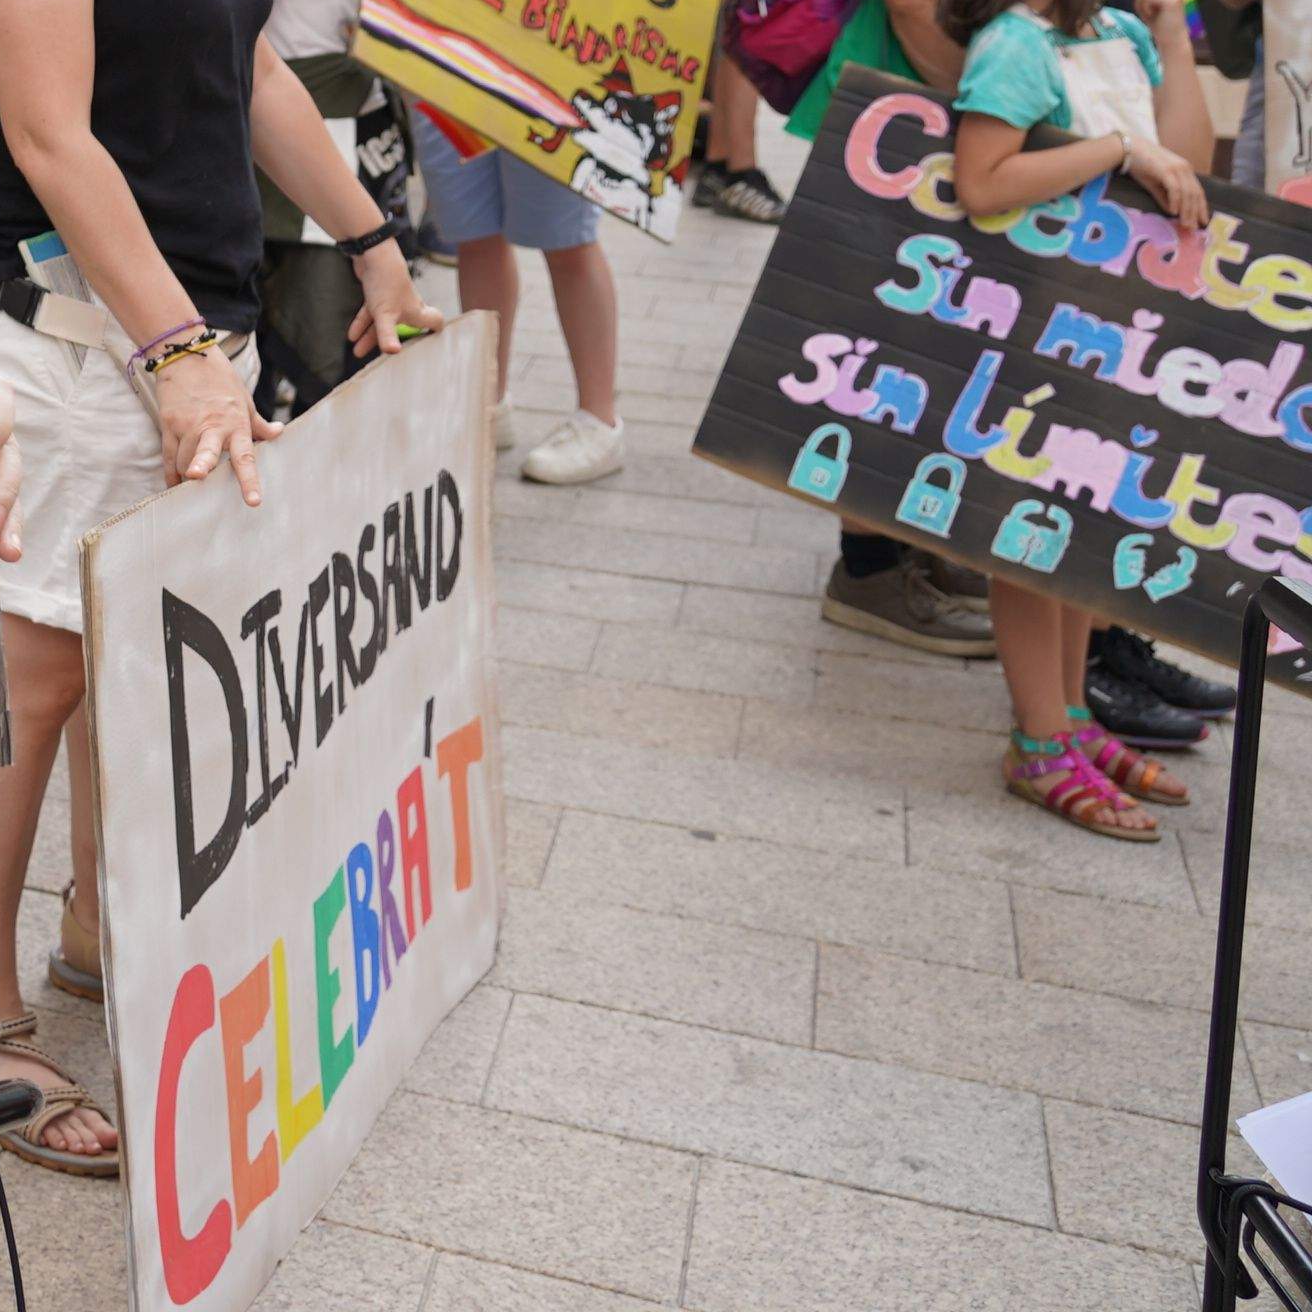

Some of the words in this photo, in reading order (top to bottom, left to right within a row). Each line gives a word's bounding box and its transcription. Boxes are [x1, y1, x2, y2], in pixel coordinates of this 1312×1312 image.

[873, 233, 1022, 340] Sin
[778, 333, 929, 434] Sin
[161, 468, 463, 920] DIVERSAND
